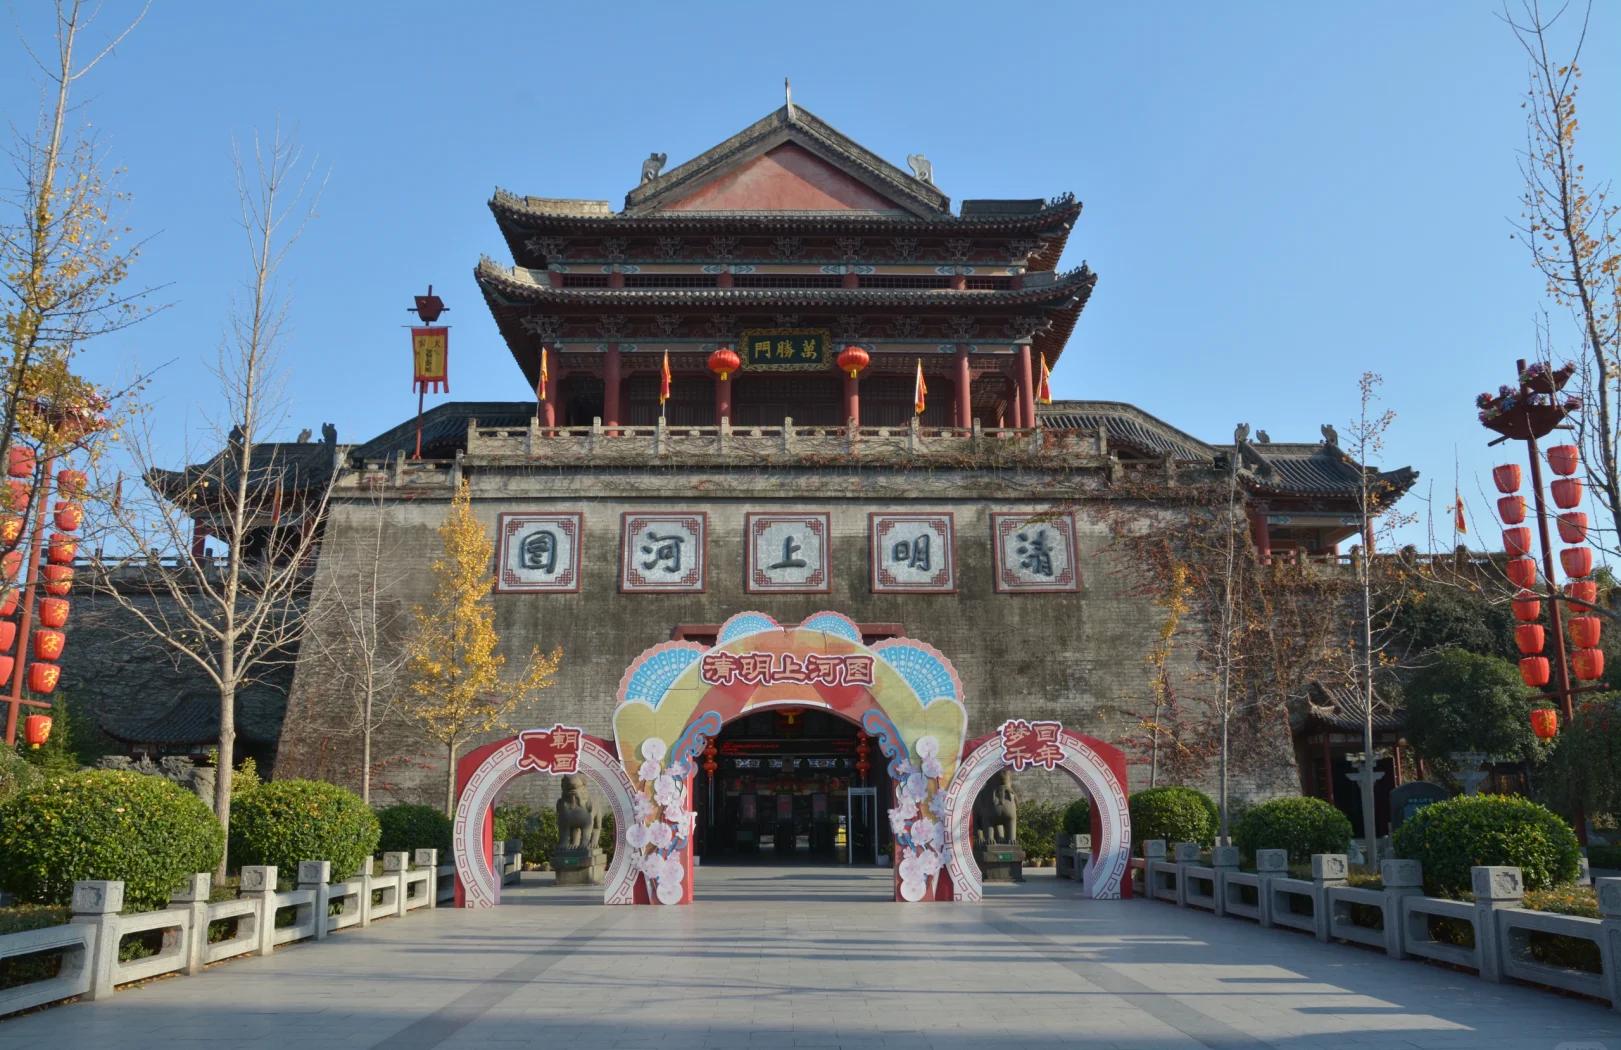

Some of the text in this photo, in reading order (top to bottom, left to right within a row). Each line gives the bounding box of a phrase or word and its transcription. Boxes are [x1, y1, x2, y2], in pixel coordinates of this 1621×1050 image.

[640, 531, 686, 573] 河
[767, 535, 807, 570] 上
[894, 532, 932, 571] 明
[43, 633, 61, 652] 宋
[43, 667, 60, 687] 宋
[702, 652, 875, 685] 清明上河图
[522, 727, 579, 749] 一朝
[1005, 722, 1059, 746] 梦回
[1005, 745, 1063, 769] 千年
